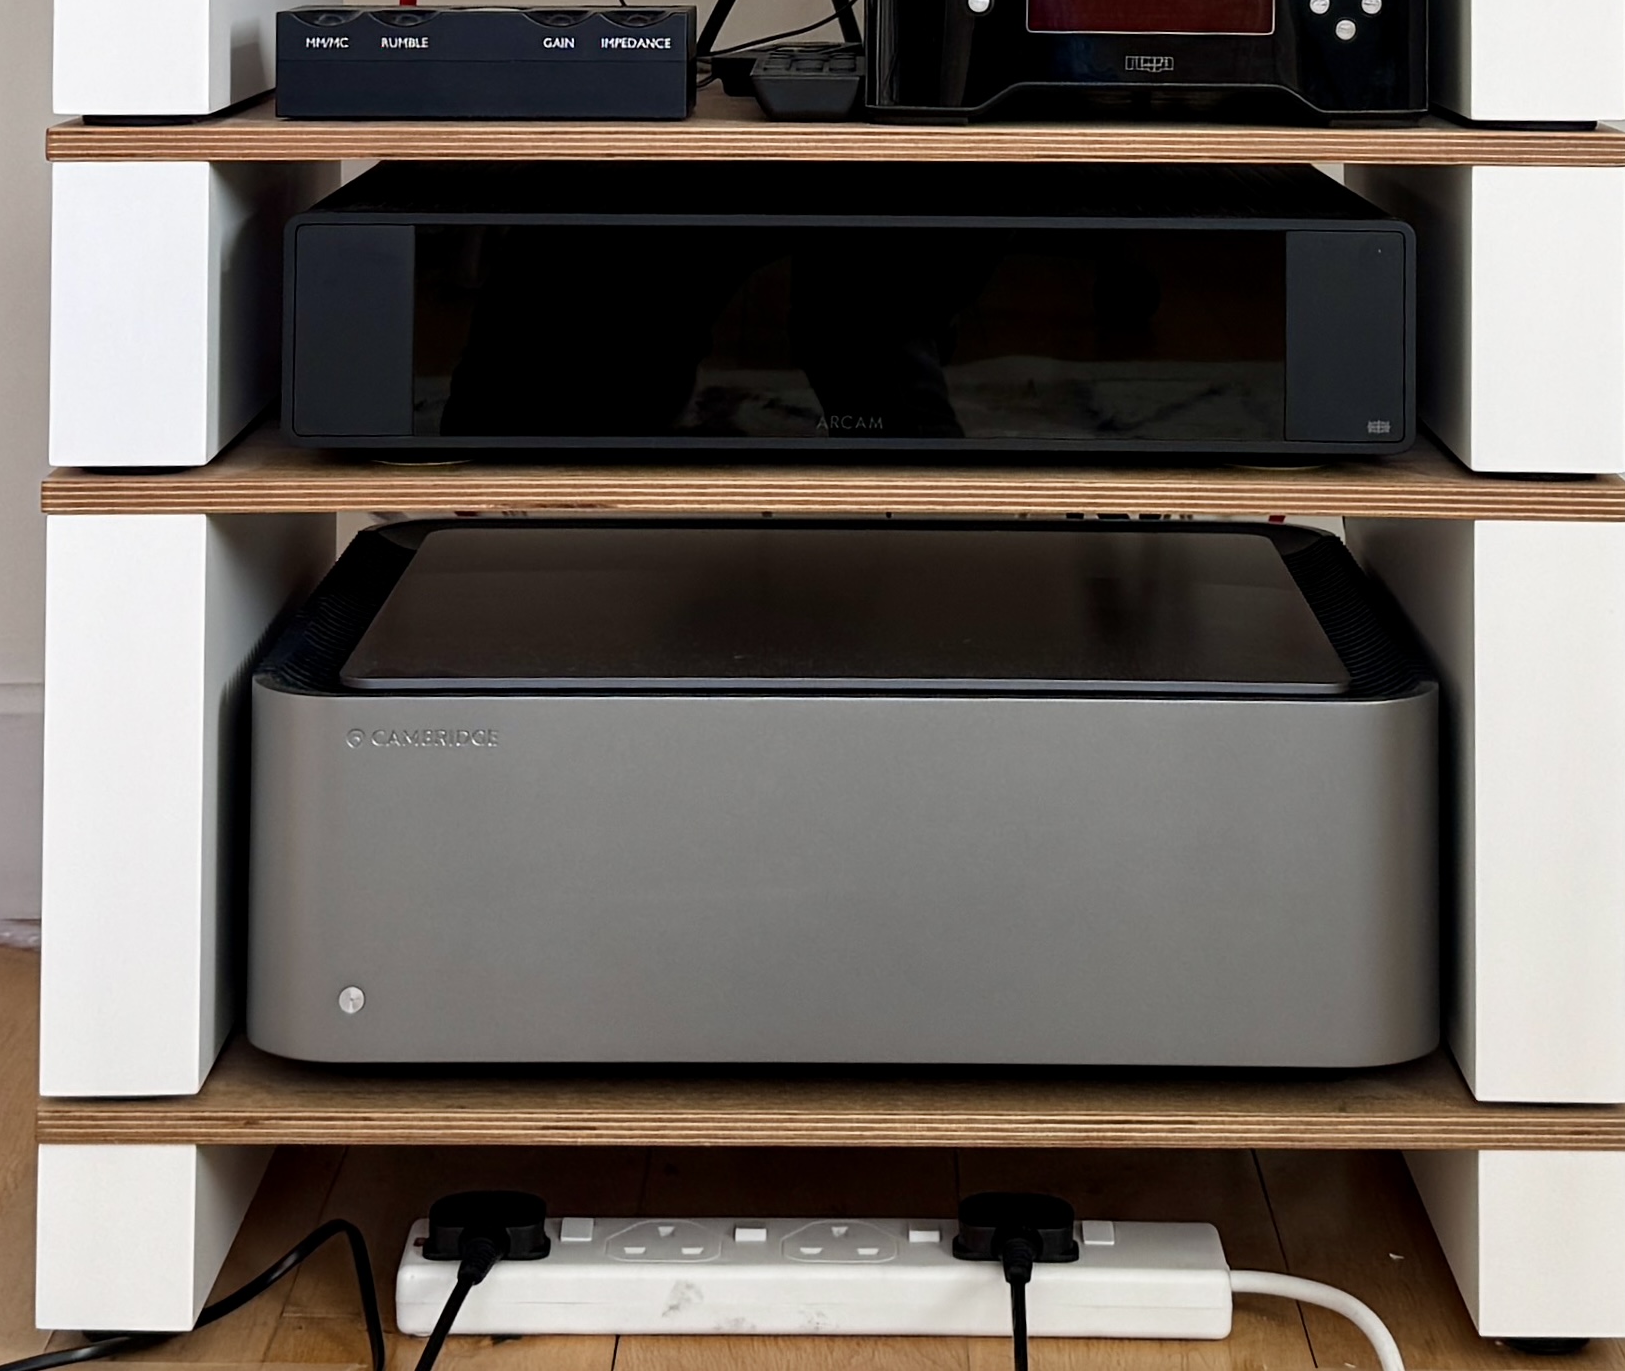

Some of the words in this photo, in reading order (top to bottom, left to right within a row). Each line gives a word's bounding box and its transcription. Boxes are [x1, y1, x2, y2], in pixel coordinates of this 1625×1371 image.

[381, 37, 429, 48] RUMBLE
[543, 37, 575, 48] GAIN
[600, 37, 672, 49] IMPEDANCE
[816, 415, 883, 429] ARCAM
[371, 729, 499, 747] CAMBRIDGE
